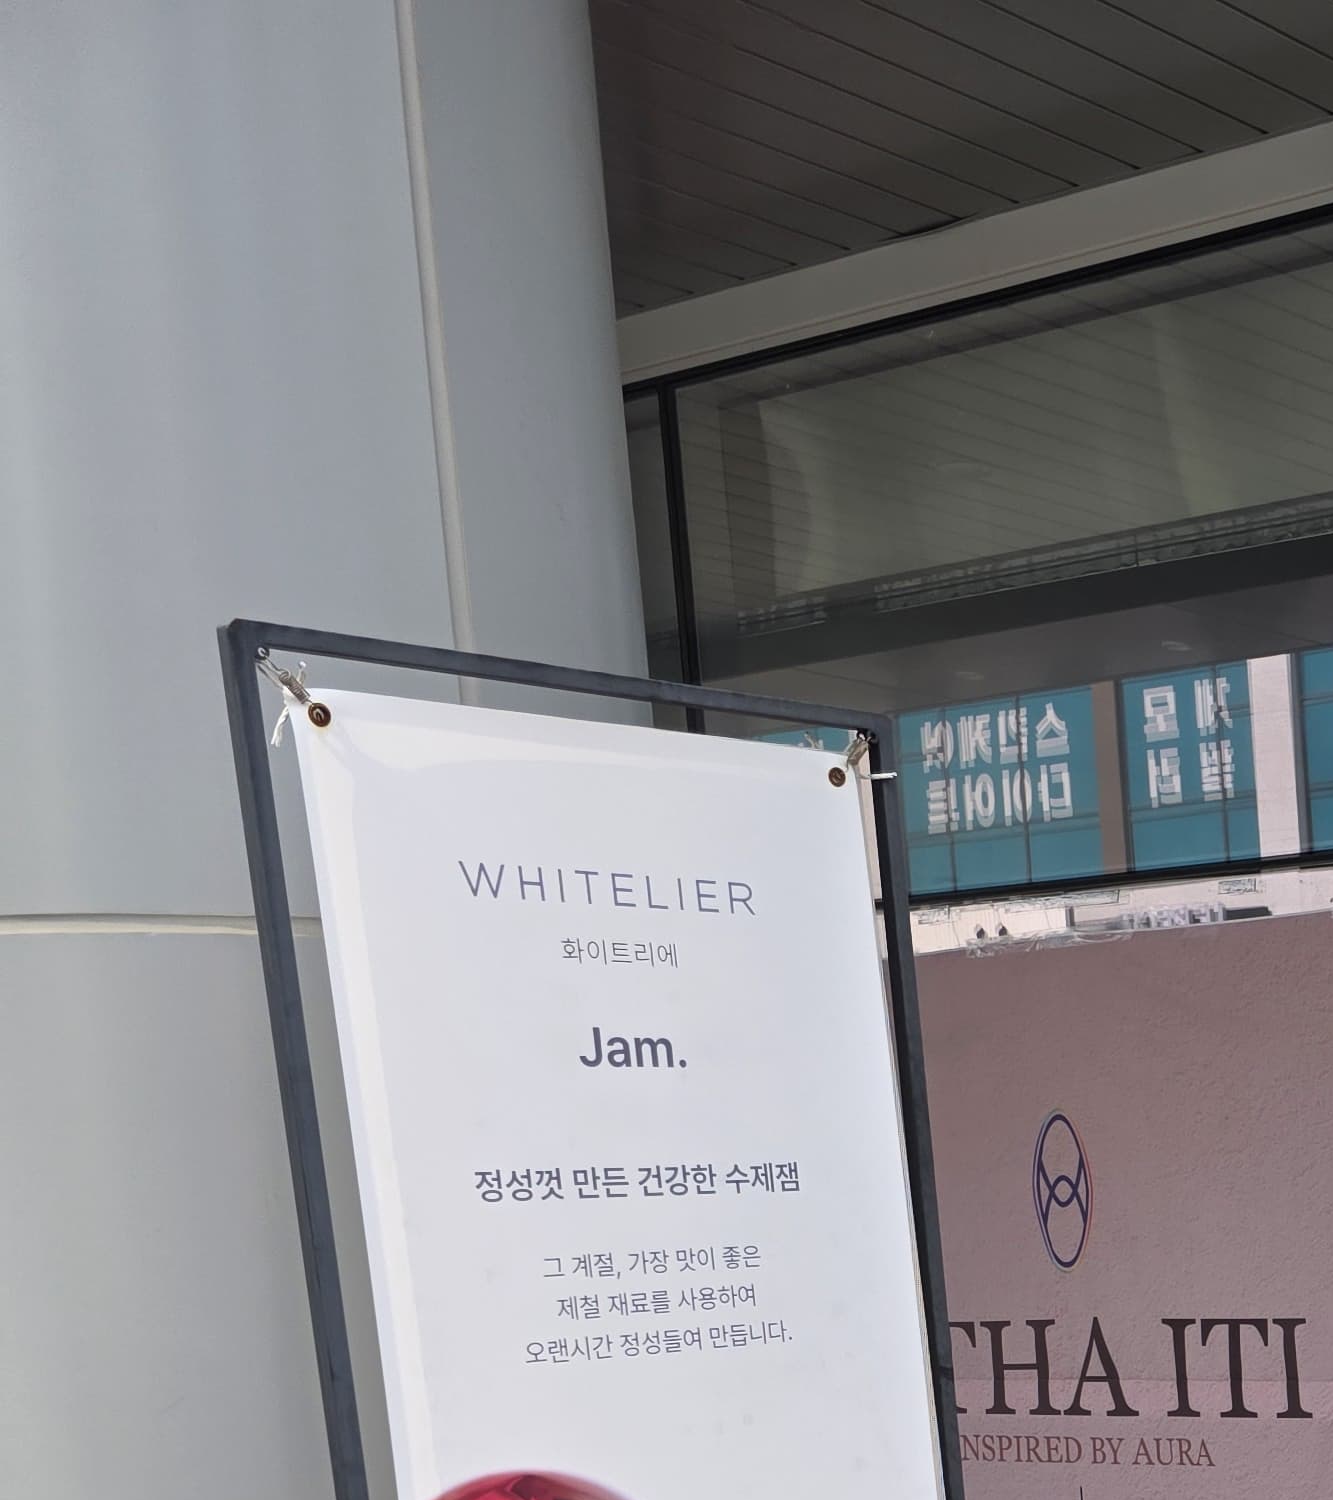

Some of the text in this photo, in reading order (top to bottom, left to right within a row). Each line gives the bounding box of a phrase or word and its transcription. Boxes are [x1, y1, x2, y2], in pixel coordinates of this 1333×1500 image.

[459, 860, 758, 917] WHITELIER
[560, 937, 680, 969] 화이트리에
[578, 1027, 688, 1070] Jam.
[474, 1160, 801, 1204] 정성껏 만든 건강한 수제잼
[543, 1243, 762, 1281] 그 계절, 가장 맛이 좋은
[557, 1283, 757, 1320] 제철 재료를 사용하여
[525, 1322, 794, 1366] 오랜시간 정성들여 만듭니다.
[1160, 1317, 1313, 1419] ITI
[960, 1434, 1215, 1468] NSPIRED BY AURA
